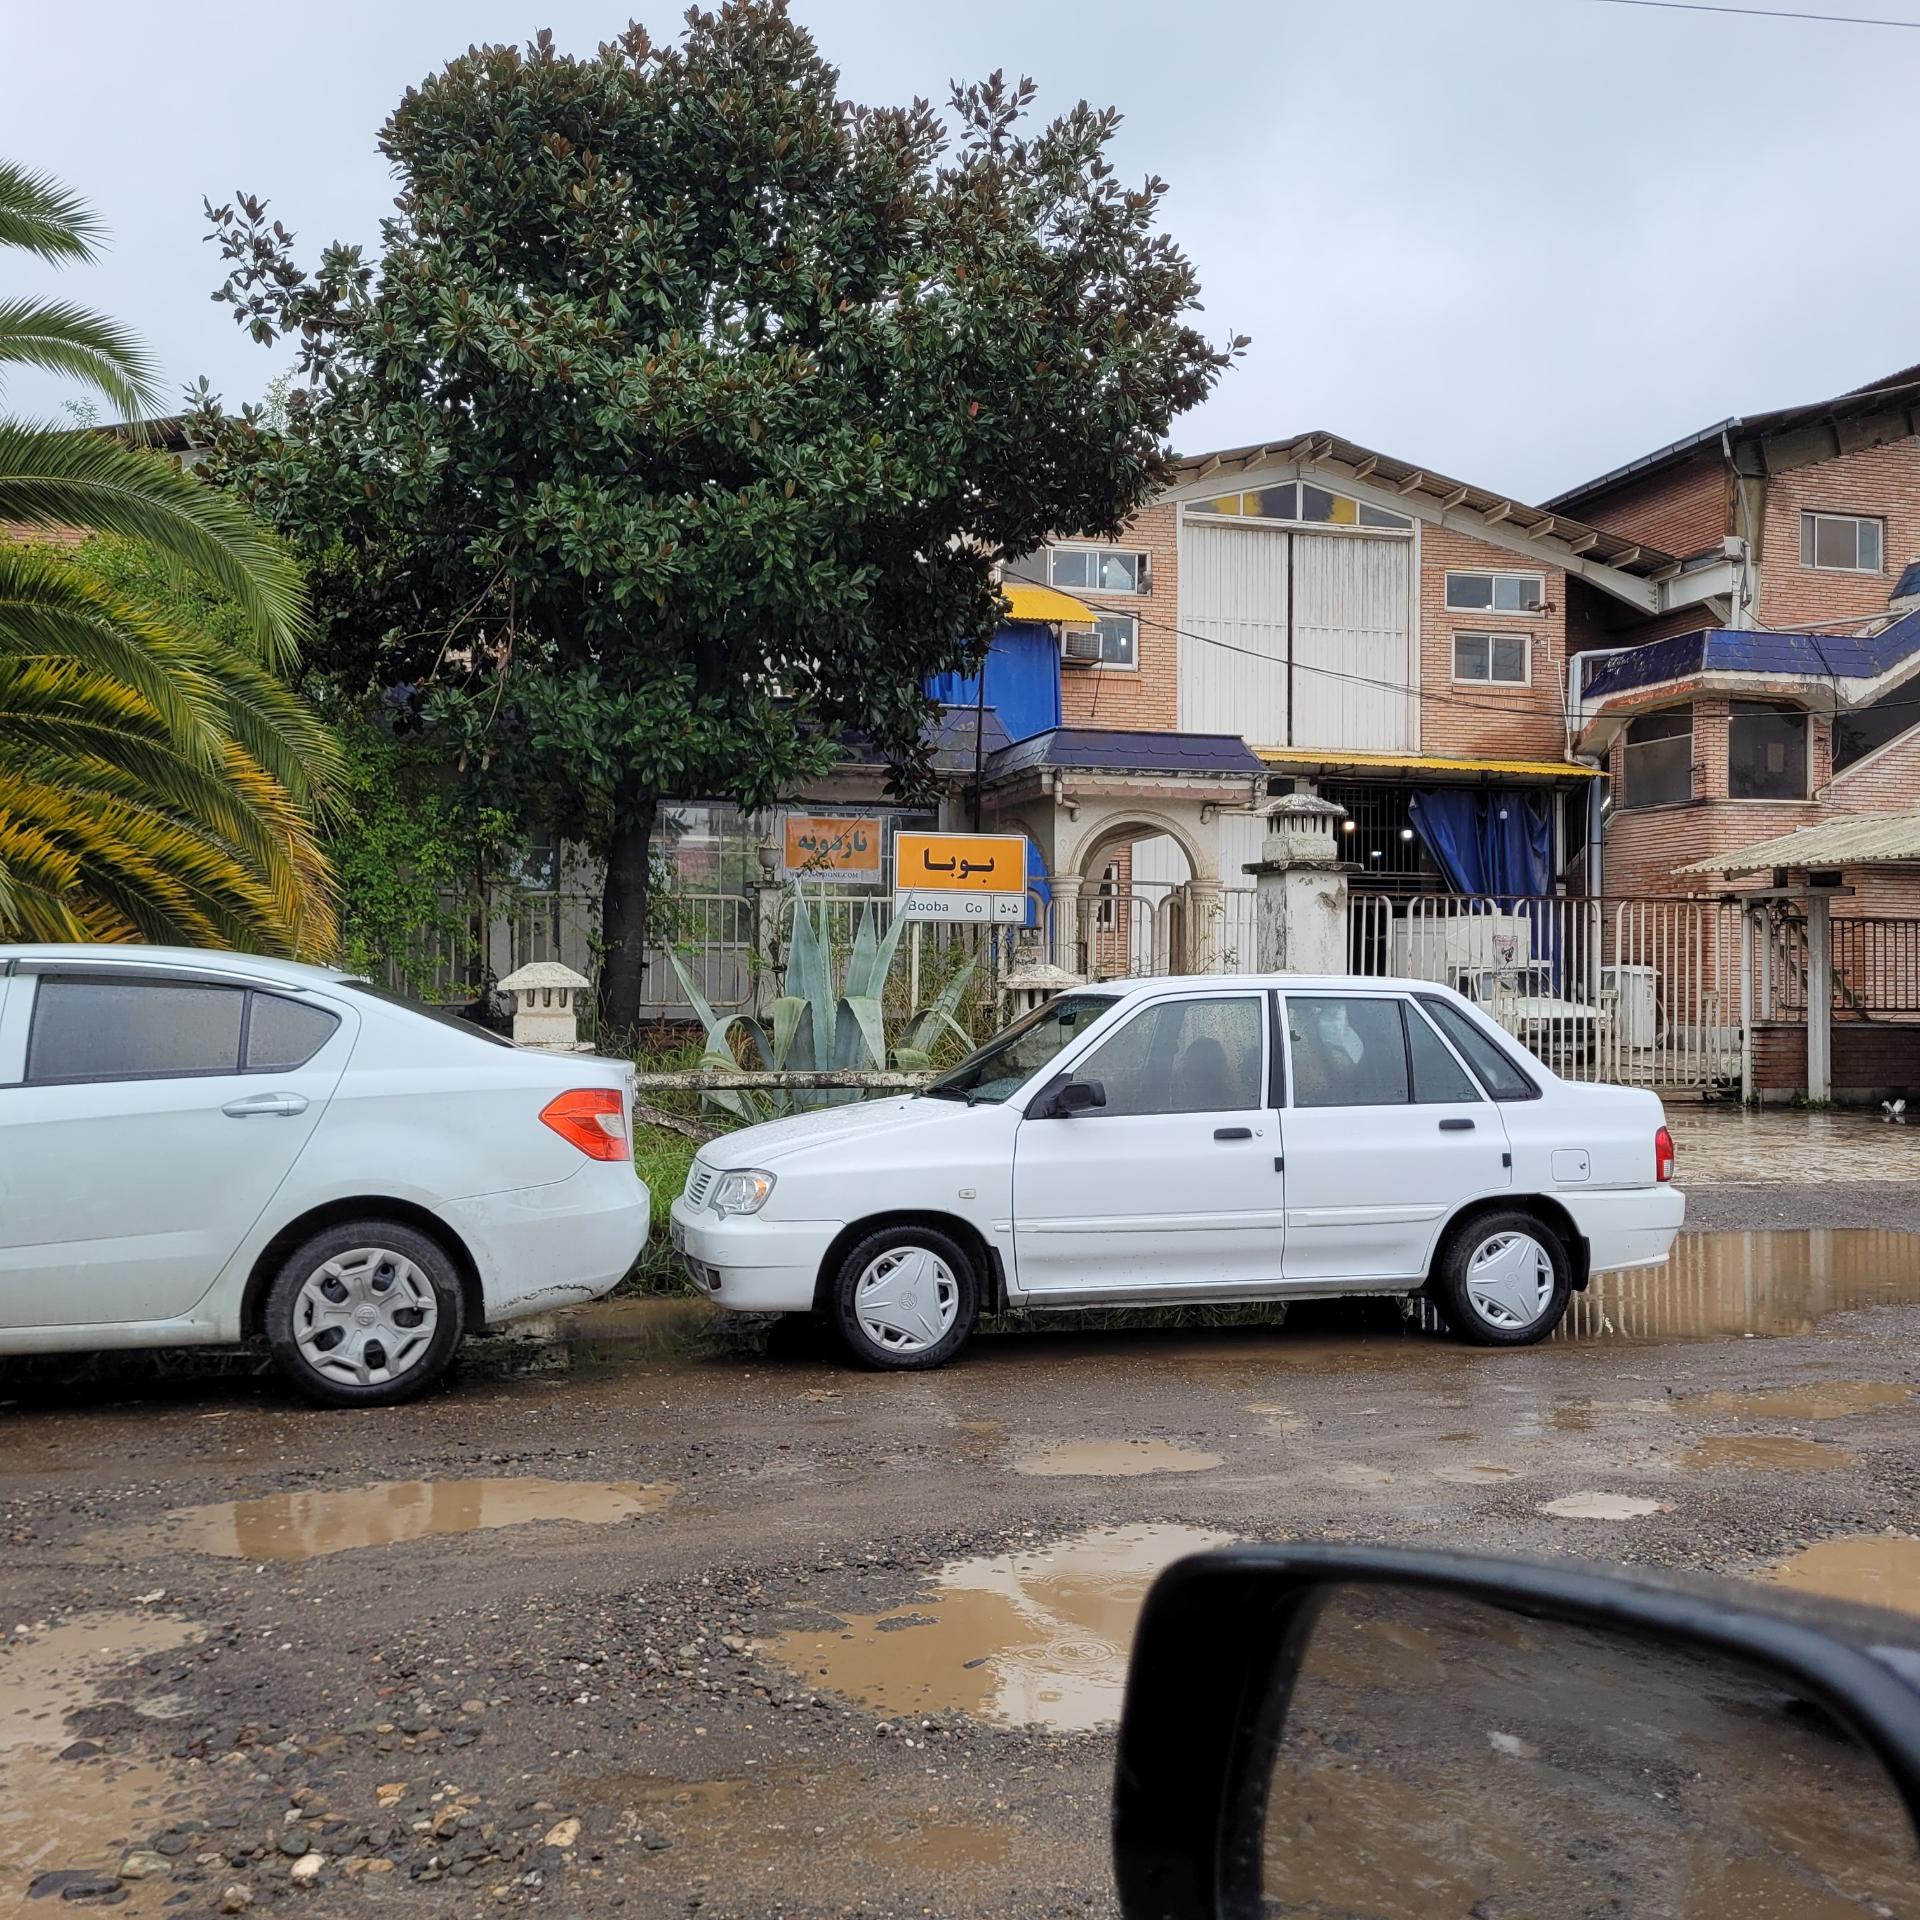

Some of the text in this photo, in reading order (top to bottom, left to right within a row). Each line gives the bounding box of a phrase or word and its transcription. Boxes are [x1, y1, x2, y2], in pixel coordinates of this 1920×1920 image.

[798, 829, 868, 858] نازدونه
[923, 847, 995, 884] بوبا
[908, 900, 983, 913] Booba Co
[1000, 903, 1018, 914] ۵۰۵
